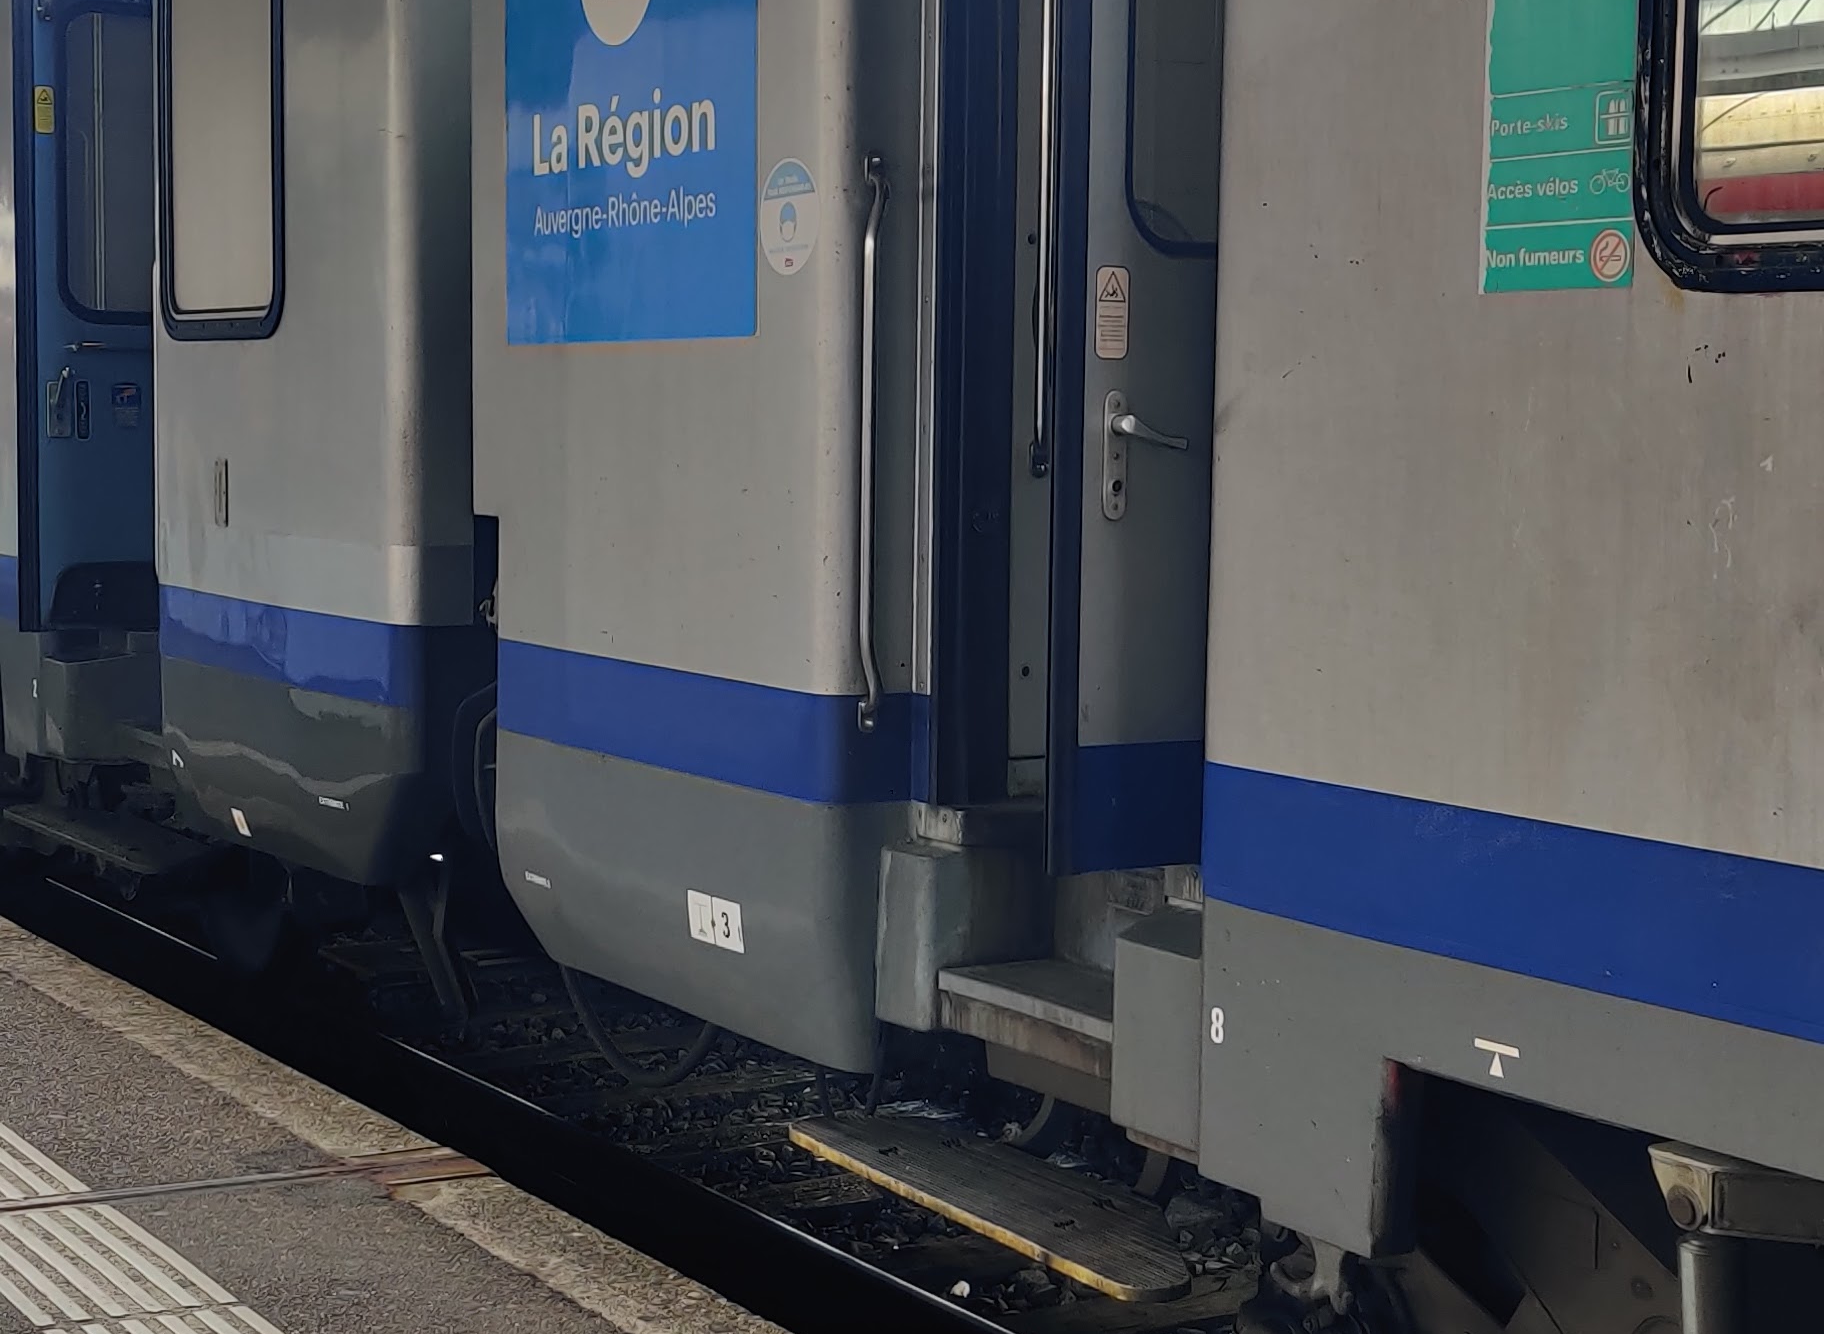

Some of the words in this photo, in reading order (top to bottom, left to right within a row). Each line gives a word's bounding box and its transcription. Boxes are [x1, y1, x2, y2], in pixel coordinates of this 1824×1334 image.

[533, 114, 568, 176] La
[577, 87, 716, 179] Région
[1491, 113, 1569, 137] Porte-skis
[1488, 180, 1533, 200] Accès
[1537, 177, 1579, 196] vélos
[533, 185, 716, 239] Auvergne-Rhône-Alpes
[1486, 250, 1515, 268] Non
[1519, 247, 1585, 266] fumeurs
[721, 911, 731, 939] 3
[1210, 1006, 1225, 1044] 8
